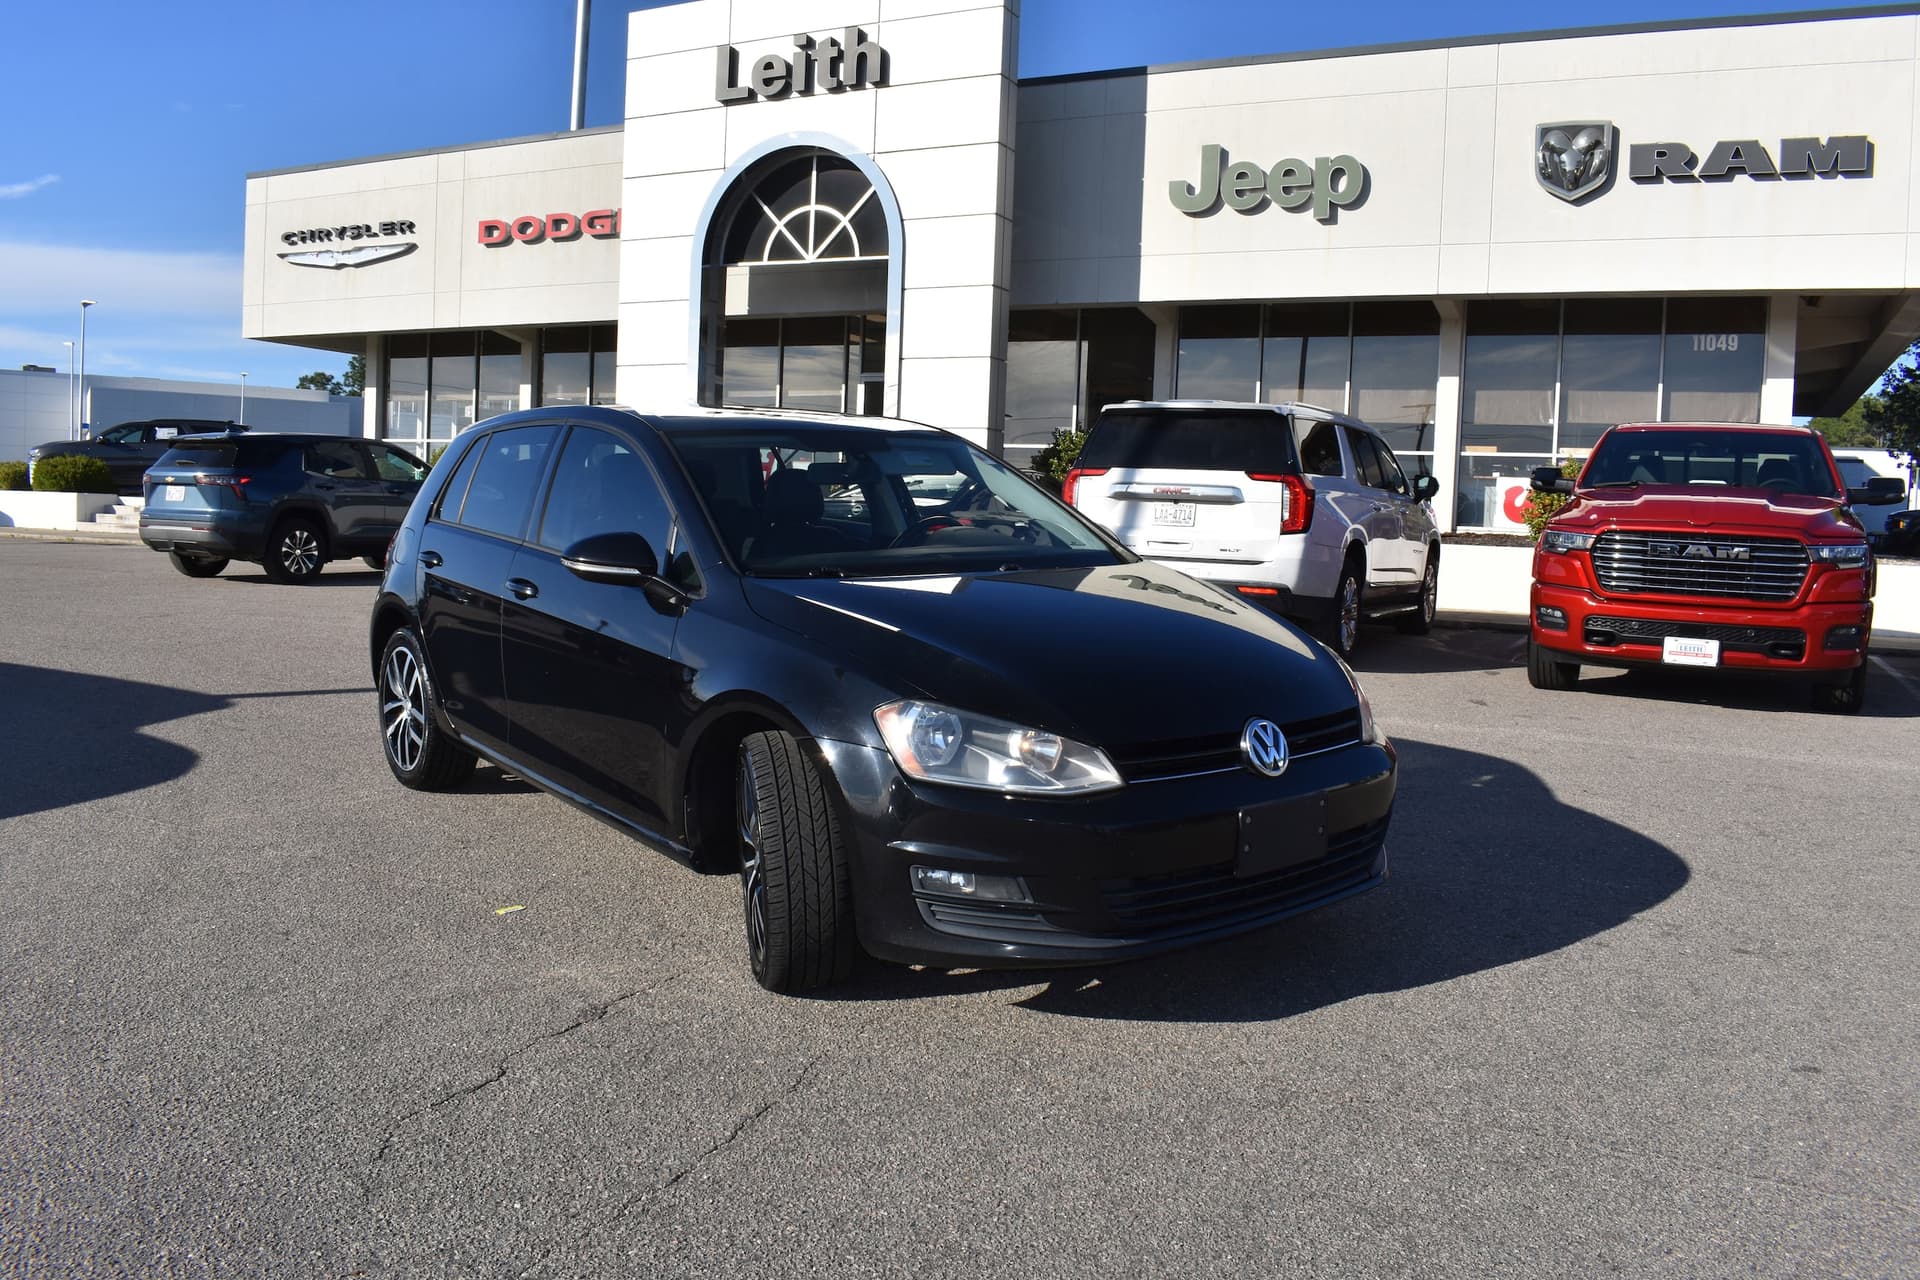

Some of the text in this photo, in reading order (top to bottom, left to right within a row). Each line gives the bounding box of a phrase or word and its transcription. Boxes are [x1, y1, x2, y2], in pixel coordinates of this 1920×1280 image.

[715, 25, 891, 107] Leith
[1629, 135, 1876, 185] RAM
[1168, 144, 1372, 226] Jeep
[281, 219, 416, 246] CHRYSLER
[478, 208, 622, 248] DODG
[1692, 334, 1739, 351] 11049
[1153, 487, 1191, 496] GMC
[1647, 541, 1750, 560] RAM
[1679, 645, 1703, 653] LEITH
[1246, 719, 1289, 776] VW
